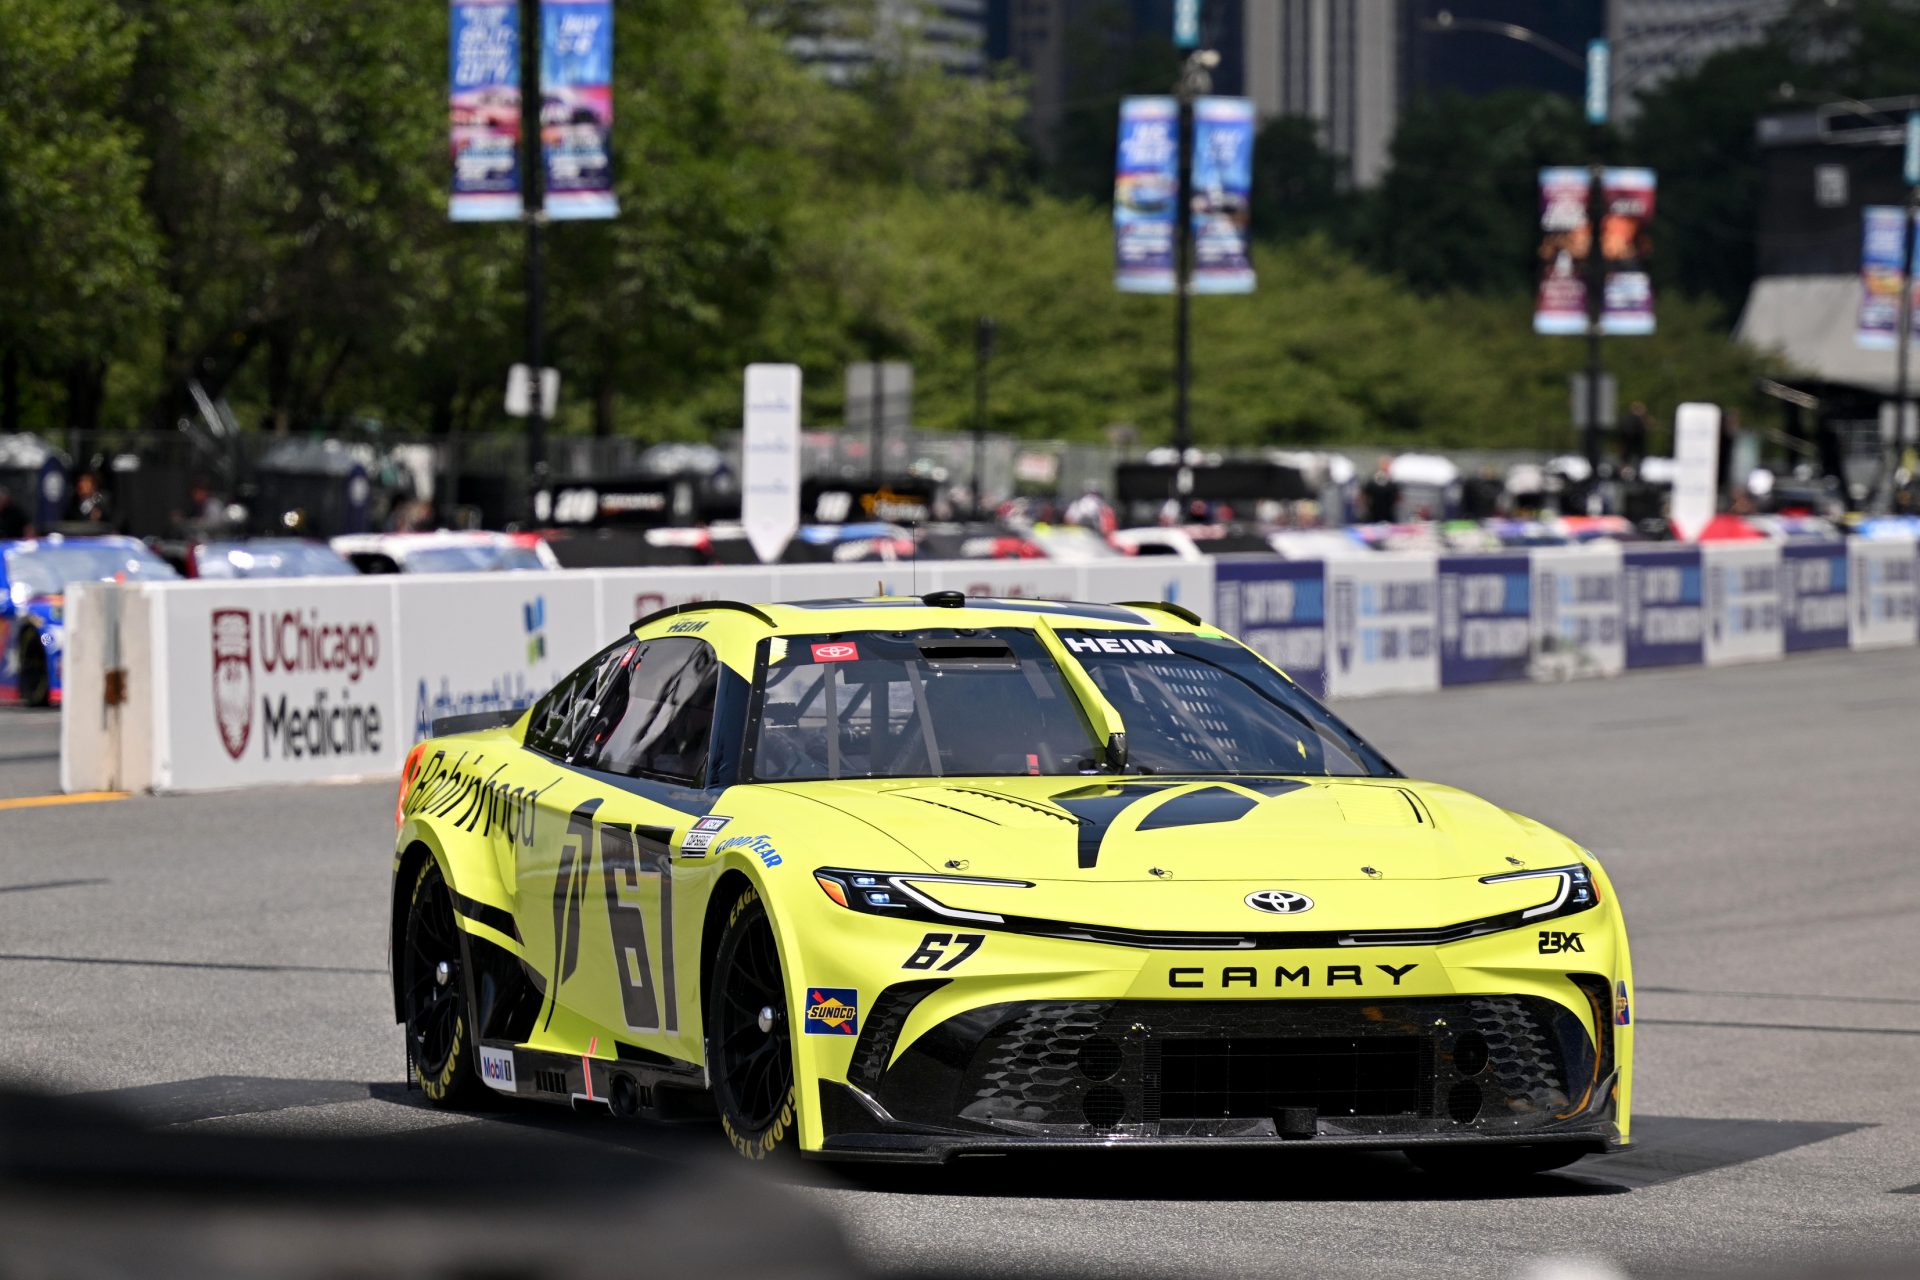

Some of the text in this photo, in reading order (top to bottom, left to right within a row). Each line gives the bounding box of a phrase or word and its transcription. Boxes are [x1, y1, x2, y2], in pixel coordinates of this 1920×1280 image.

[259, 608, 379, 682] UChicago
[1064, 637, 1176, 655] HEIM
[262, 687, 382, 760] Medicine
[404, 750, 563, 848] Robinhood
[715, 834, 783, 869] GOODYEAR
[600, 822, 680, 1035] 67
[901, 932, 987, 972] 67
[1168, 963, 1420, 989] CAMRY
[810, 1006, 854, 1019] SUNOCO
[483, 1056, 504, 1080] Mobil
